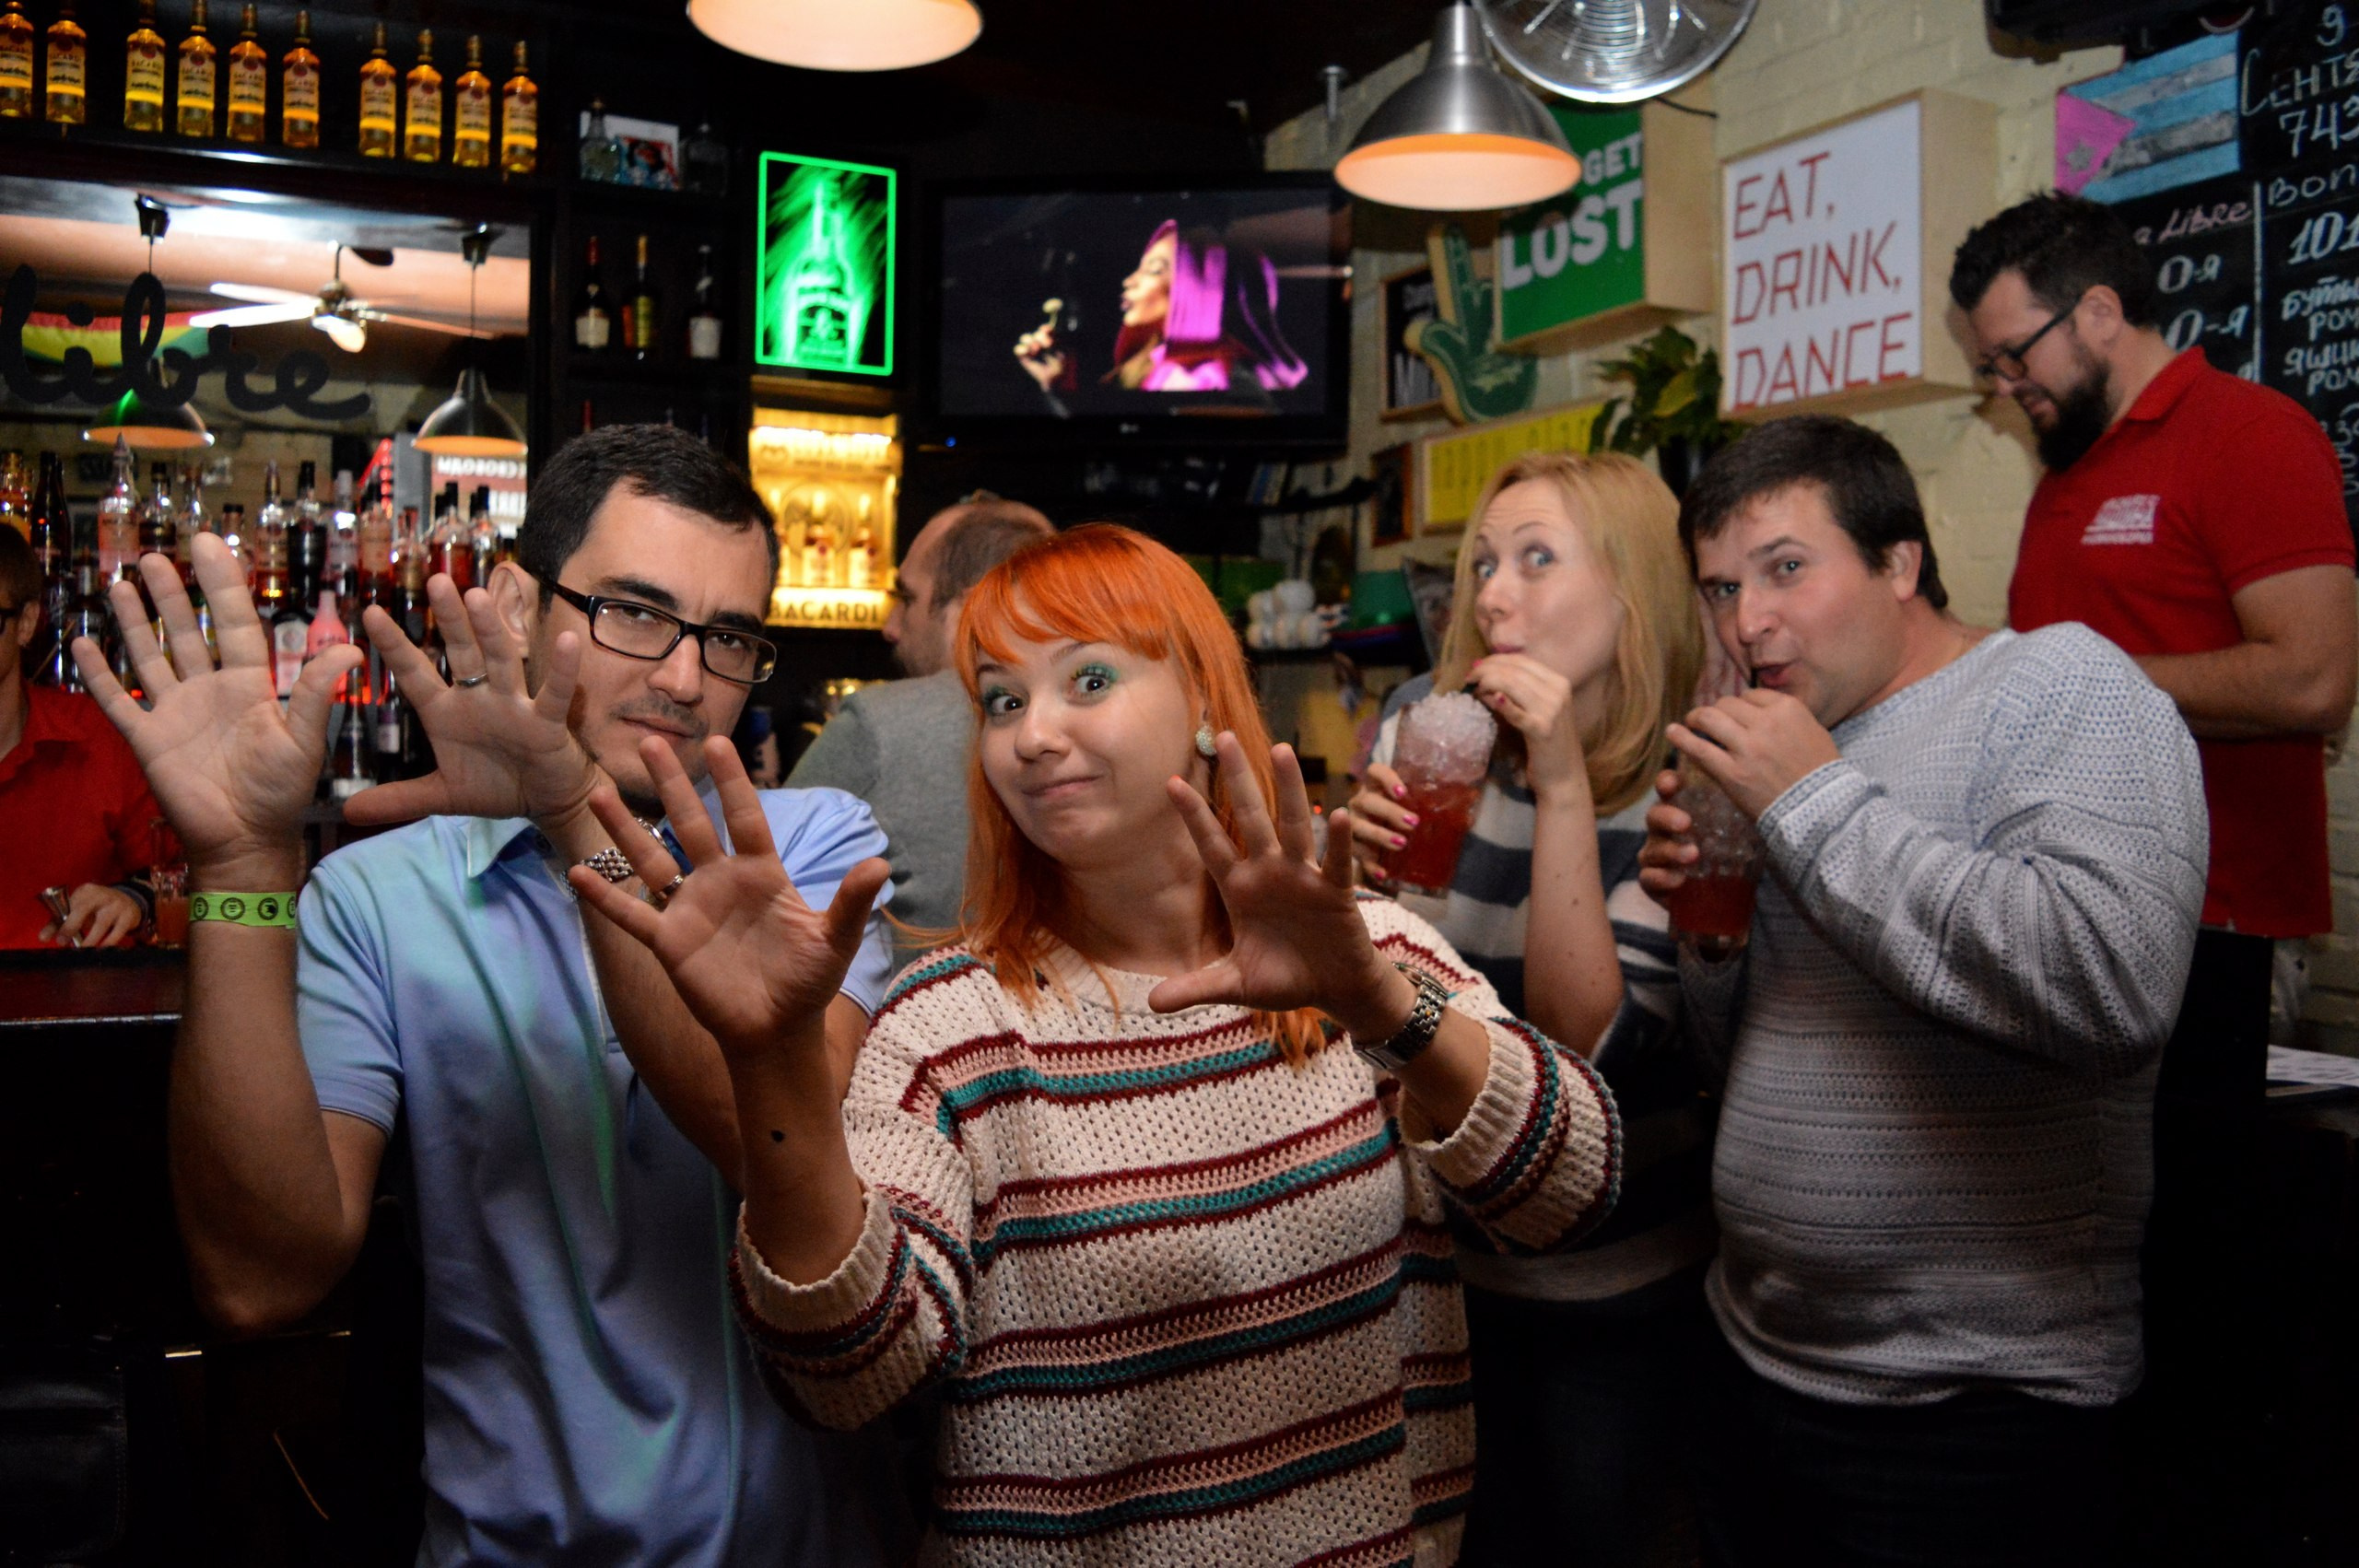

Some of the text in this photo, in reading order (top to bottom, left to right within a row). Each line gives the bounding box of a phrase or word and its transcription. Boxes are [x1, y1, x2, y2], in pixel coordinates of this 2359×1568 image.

[1583, 132, 1642, 184] GET
[1733, 151, 1835, 240] EAT,
[1501, 178, 1643, 290] LOST
[1731, 220, 1902, 325] DRINK,
[1731, 311, 1913, 412] DANCE
